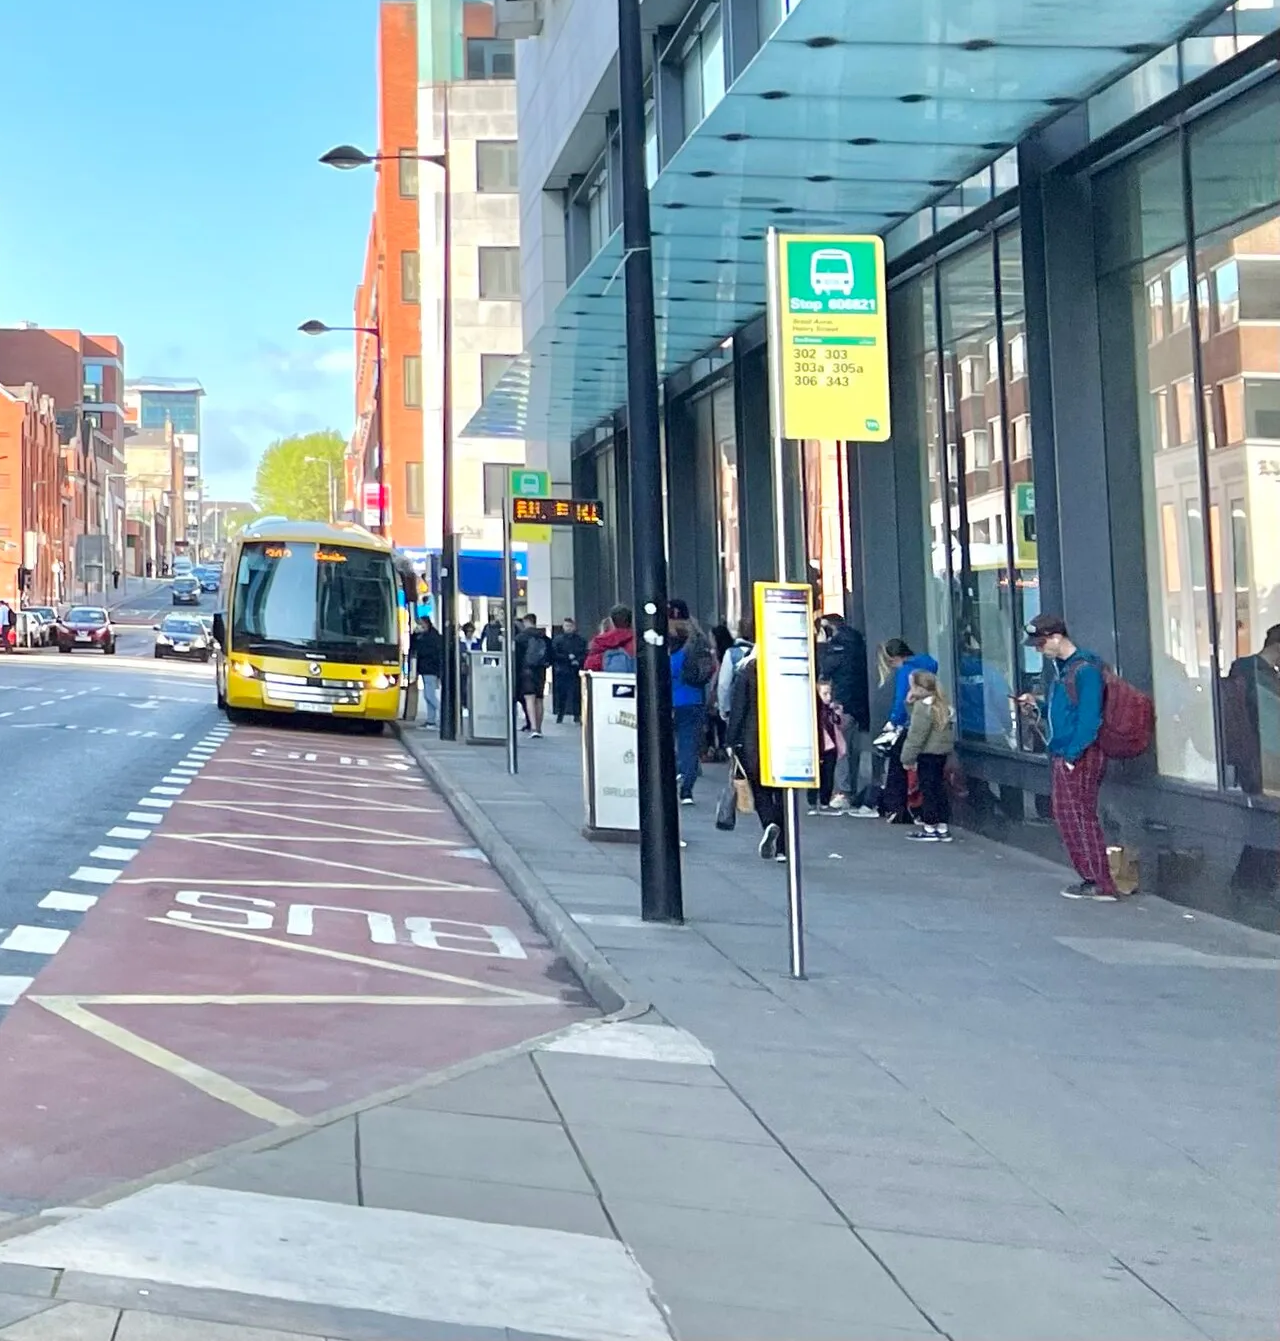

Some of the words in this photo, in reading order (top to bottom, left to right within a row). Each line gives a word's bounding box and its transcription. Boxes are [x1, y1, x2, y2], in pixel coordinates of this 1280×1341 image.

[790, 297, 823, 312] Stop
[793, 348, 816, 359] 302
[824, 349, 848, 359] 303
[794, 362, 824, 372] 303a
[832, 363, 864, 373] 305a
[794, 376, 818, 386] 306
[826, 376, 849, 386] 343
[165, 890, 528, 959] BUS
